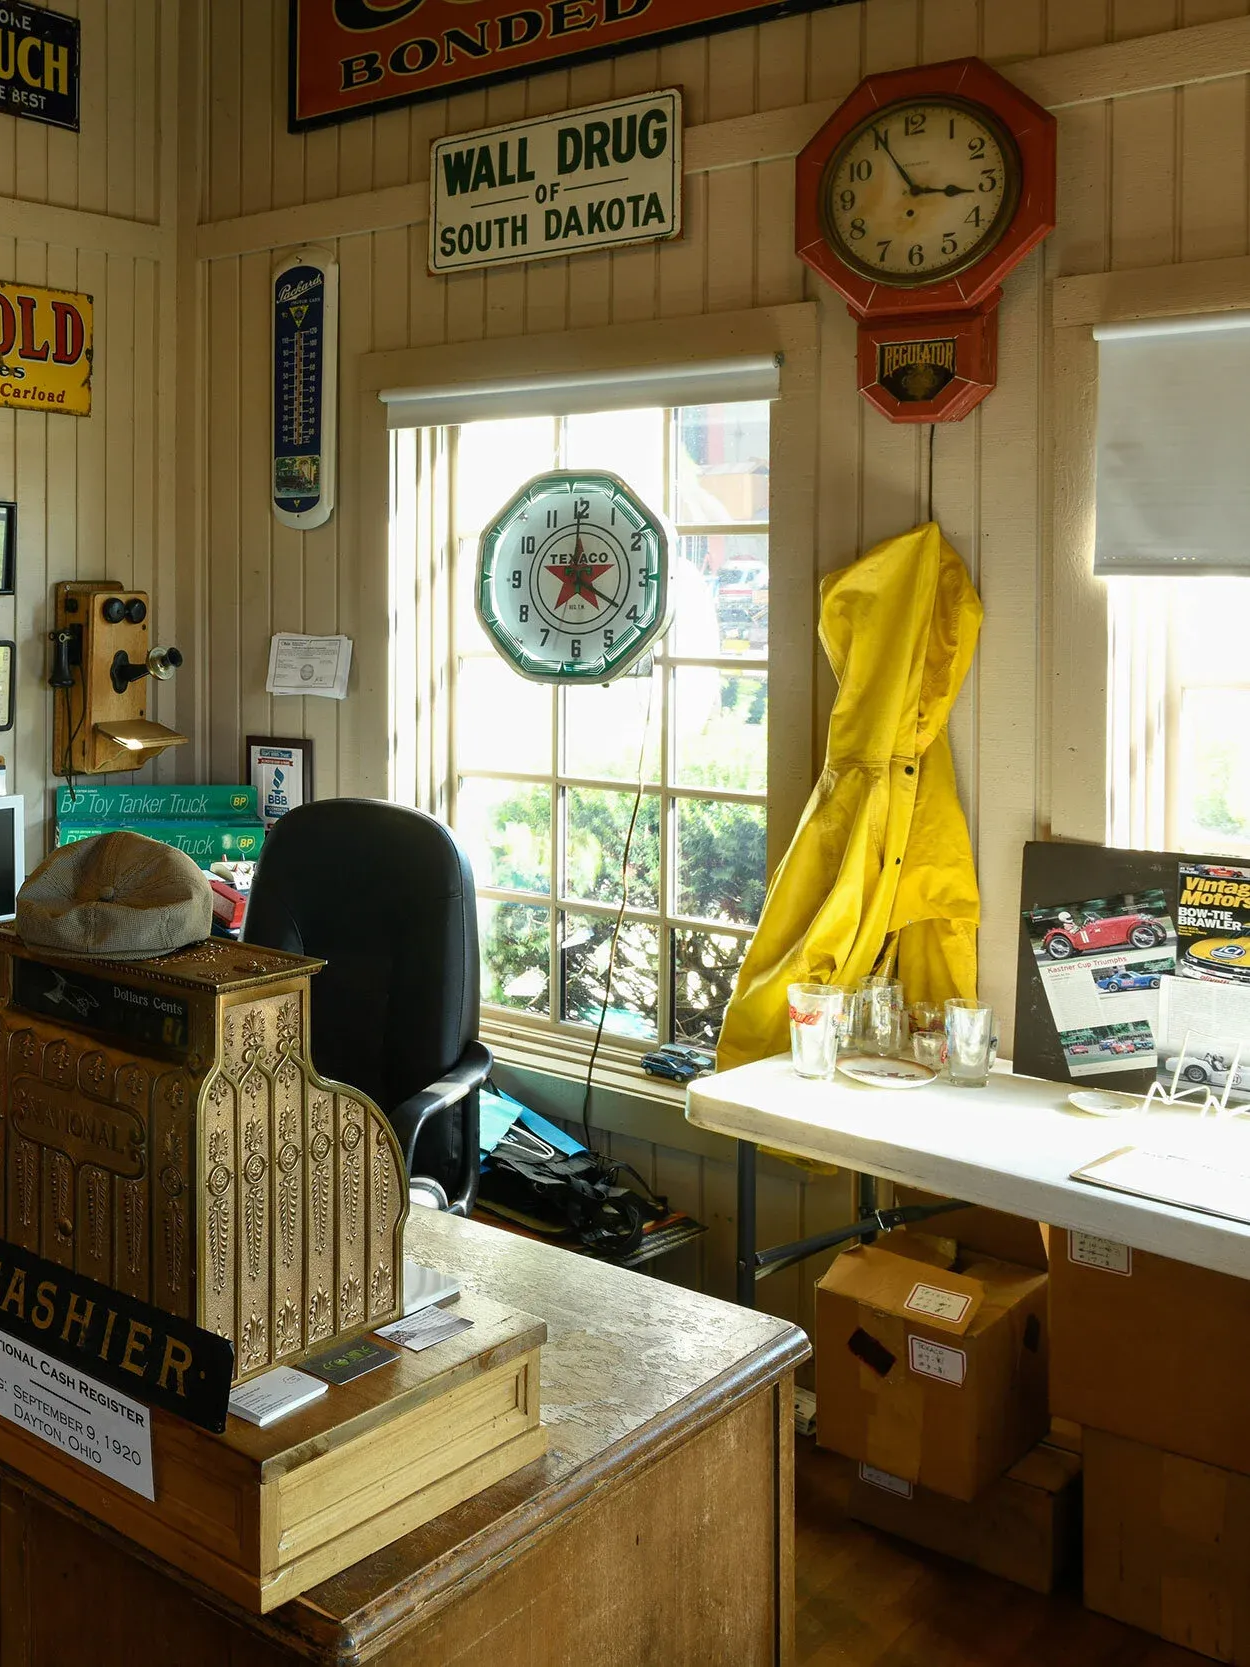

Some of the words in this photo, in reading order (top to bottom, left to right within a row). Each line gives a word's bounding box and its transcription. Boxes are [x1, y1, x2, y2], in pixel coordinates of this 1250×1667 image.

[339, 0, 650, 92] BONDED
[12, 87, 46, 110] BEST
[904, 113, 927, 137] 12
[949, 118, 955, 139] 1
[442, 137, 536, 197] WALL
[557, 109, 668, 175] DRUG
[968, 137, 987, 161] 2
[849, 159, 873, 182] 10
[978, 169, 997, 193] 3
[535, 183, 560, 204] OF
[840, 190, 856, 211] 9
[440, 214, 528, 257] SOUTH
[544, 192, 666, 240] DAKOTA
[963, 205, 985, 228] 4
[850, 217, 866, 240] 8
[876, 240, 893, 262] 7
[941, 232, 958, 255] 5
[908, 244, 925, 266] 6
[277, 273, 323, 304] Packard
[883, 341, 954, 376] REGULATOR
[0, 383, 65, 404] Carload
[547, 510, 557, 528] 11
[574, 500, 590, 519] 12
[611, 507, 615, 526] 1
[521, 536, 535, 554] 10
[631, 533, 642, 551] 2
[550, 552, 609, 565] TEXACO
[512, 570, 522, 588] 9
[638, 568, 649, 588] 3
[519, 605, 529, 622] 8
[625, 605, 639, 622] 4
[540, 629, 550, 647] 7
[604, 630, 614, 648] 5
[571, 640, 581, 658] 6
[61, 794, 85, 813] BP
[89, 794, 112, 817] Toy
[119, 794, 165, 813] Tanker
[170, 794, 208, 813] Truck
[233, 797, 246, 806] BP
[268, 795, 288, 805] BBB
[175, 835, 215, 854] Truck
[239, 838, 253, 848] BP
[1178, 906, 1233, 921] BOW-TIE
[1178, 916, 1242, 932] BRAWLER
[1047, 963, 1075, 974] Kastner
[1077, 961, 1092, 971] Cup
[1093, 956, 1127, 967] Triumphs
[113, 986, 149, 1008] Dollars
[153, 997, 182, 1016] Cents
[40, 1360, 76, 1391] CASH
[79, 1381, 145, 1429] REGISTER
[13, 1384, 84, 1435] SEPTEMBER
[86, 1425, 99, 1445] 9,
[105, 1435, 142, 1467] 1920
[13, 1404, 66, 1445] DAYTON,
[68, 1435, 102, 1465] OHIO
